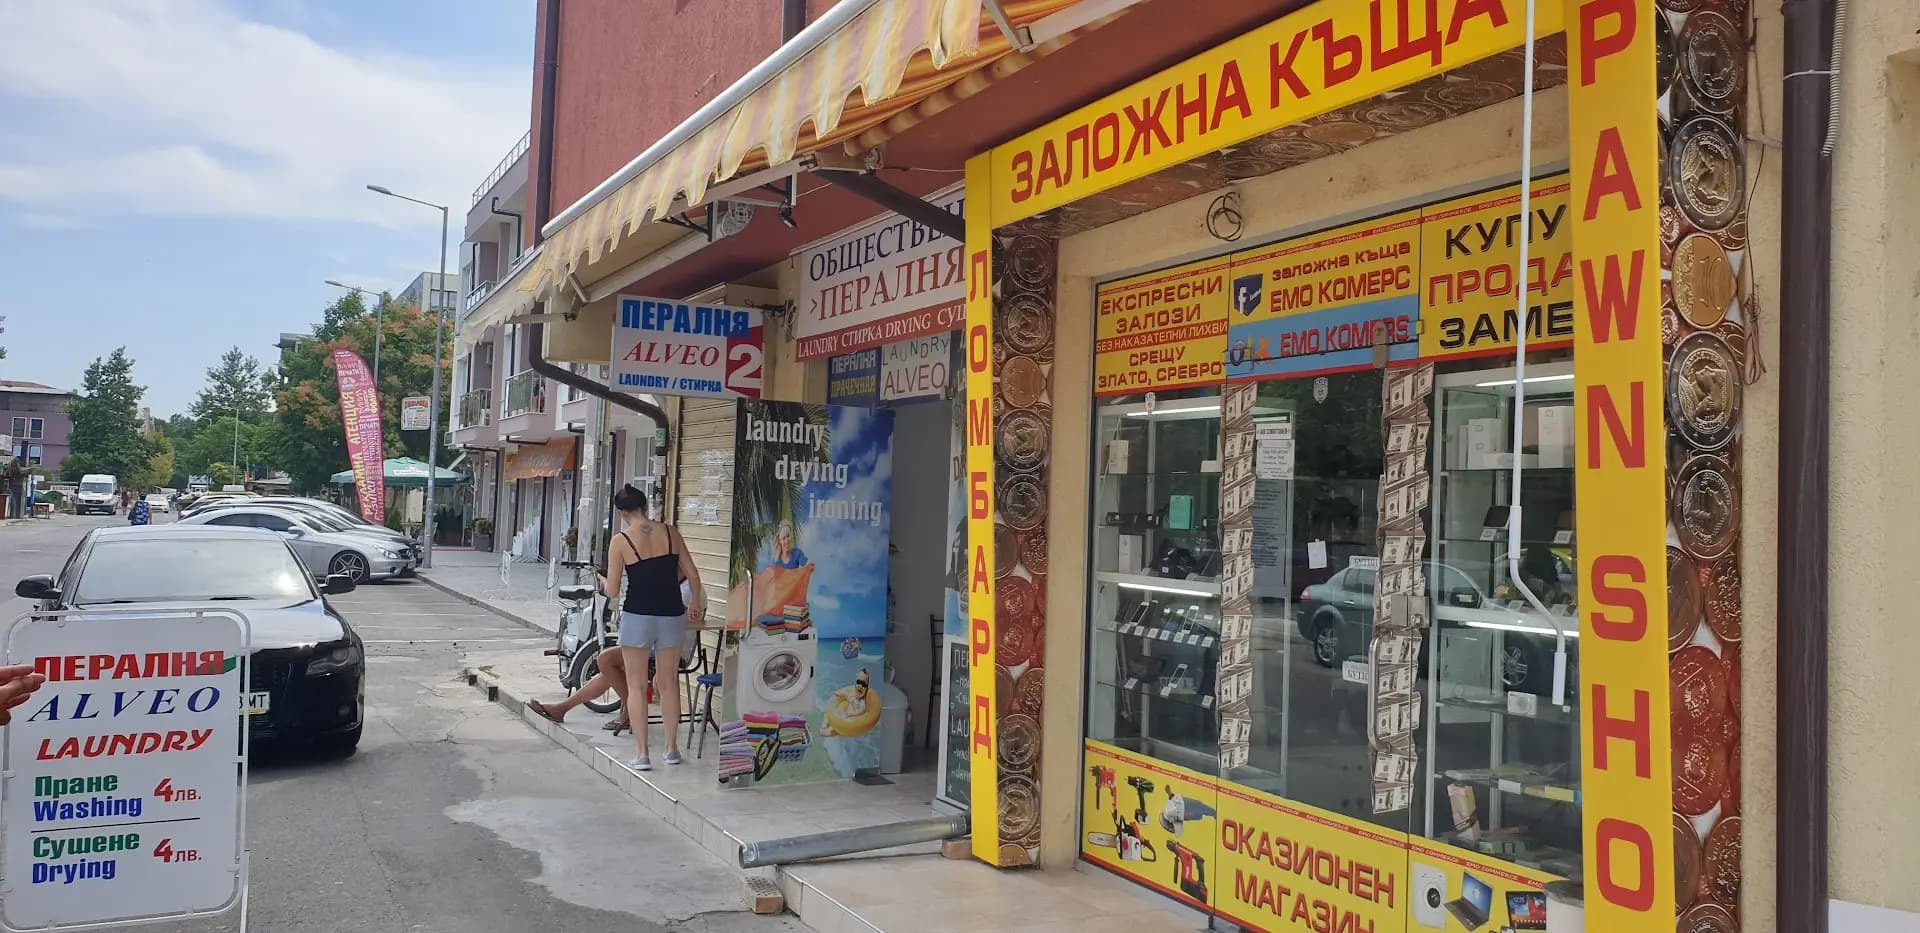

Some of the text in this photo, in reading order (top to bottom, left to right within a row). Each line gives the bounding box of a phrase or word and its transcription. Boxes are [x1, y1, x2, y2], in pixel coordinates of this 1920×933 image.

[1010, 59, 1251, 203] ЗАЛОЖНА
[1579, 0, 1647, 471] PAWN
[1272, 254, 1350, 281] заложна
[1356, 241, 1410, 265] къща
[820, 245, 965, 320] ПЕРАЛНЯ
[1100, 276, 1222, 316] ЕКСПРЕСНИ
[1271, 284, 1313, 313] ЕМО
[1320, 265, 1411, 304] КОМЕРС
[622, 299, 749, 338] ПЕРАЛНЯ
[1116, 304, 1201, 334] ЗАЛОЗИ
[798, 335, 840, 358] LAUNDRY
[841, 325, 883, 348] СТИРКА
[885, 313, 931, 338] DRYING
[883, 336, 950, 366] LAUNDRY
[1096, 321, 1228, 352] БЕЗ НАКАЗАТЕЛНИ ЛИХВИ
[1281, 329, 1320, 357] EMO
[623, 341, 764, 389] ALVEO 2
[1129, 346, 1186, 367] СРЕЩУ
[619, 373, 669, 389] LAUNDRY
[681, 378, 722, 393] СТИРКА
[884, 362, 946, 395] ALVEO
[1098, 361, 1222, 388] ЗЛАТО, СРЕБРО
[341, 391, 361, 445] АГЕНЦИЯ
[746, 413, 825, 452] laundry
[775, 455, 848, 488] drying
[808, 493, 882, 527] ironing
[969, 249, 992, 760] ЛОМБАРД
[34, 651, 225, 682] ПЕРАЛНЯ
[25, 686, 221, 722] ALVEO
[36, 728, 214, 761] LAUNDRY
[34, 775, 118, 799] Пране
[34, 796, 143, 822] Washing
[33, 832, 140, 860] Сушене
[32, 859, 116, 884] Drying
[1222, 819, 1394, 909] ОКАЗИОНЕН
